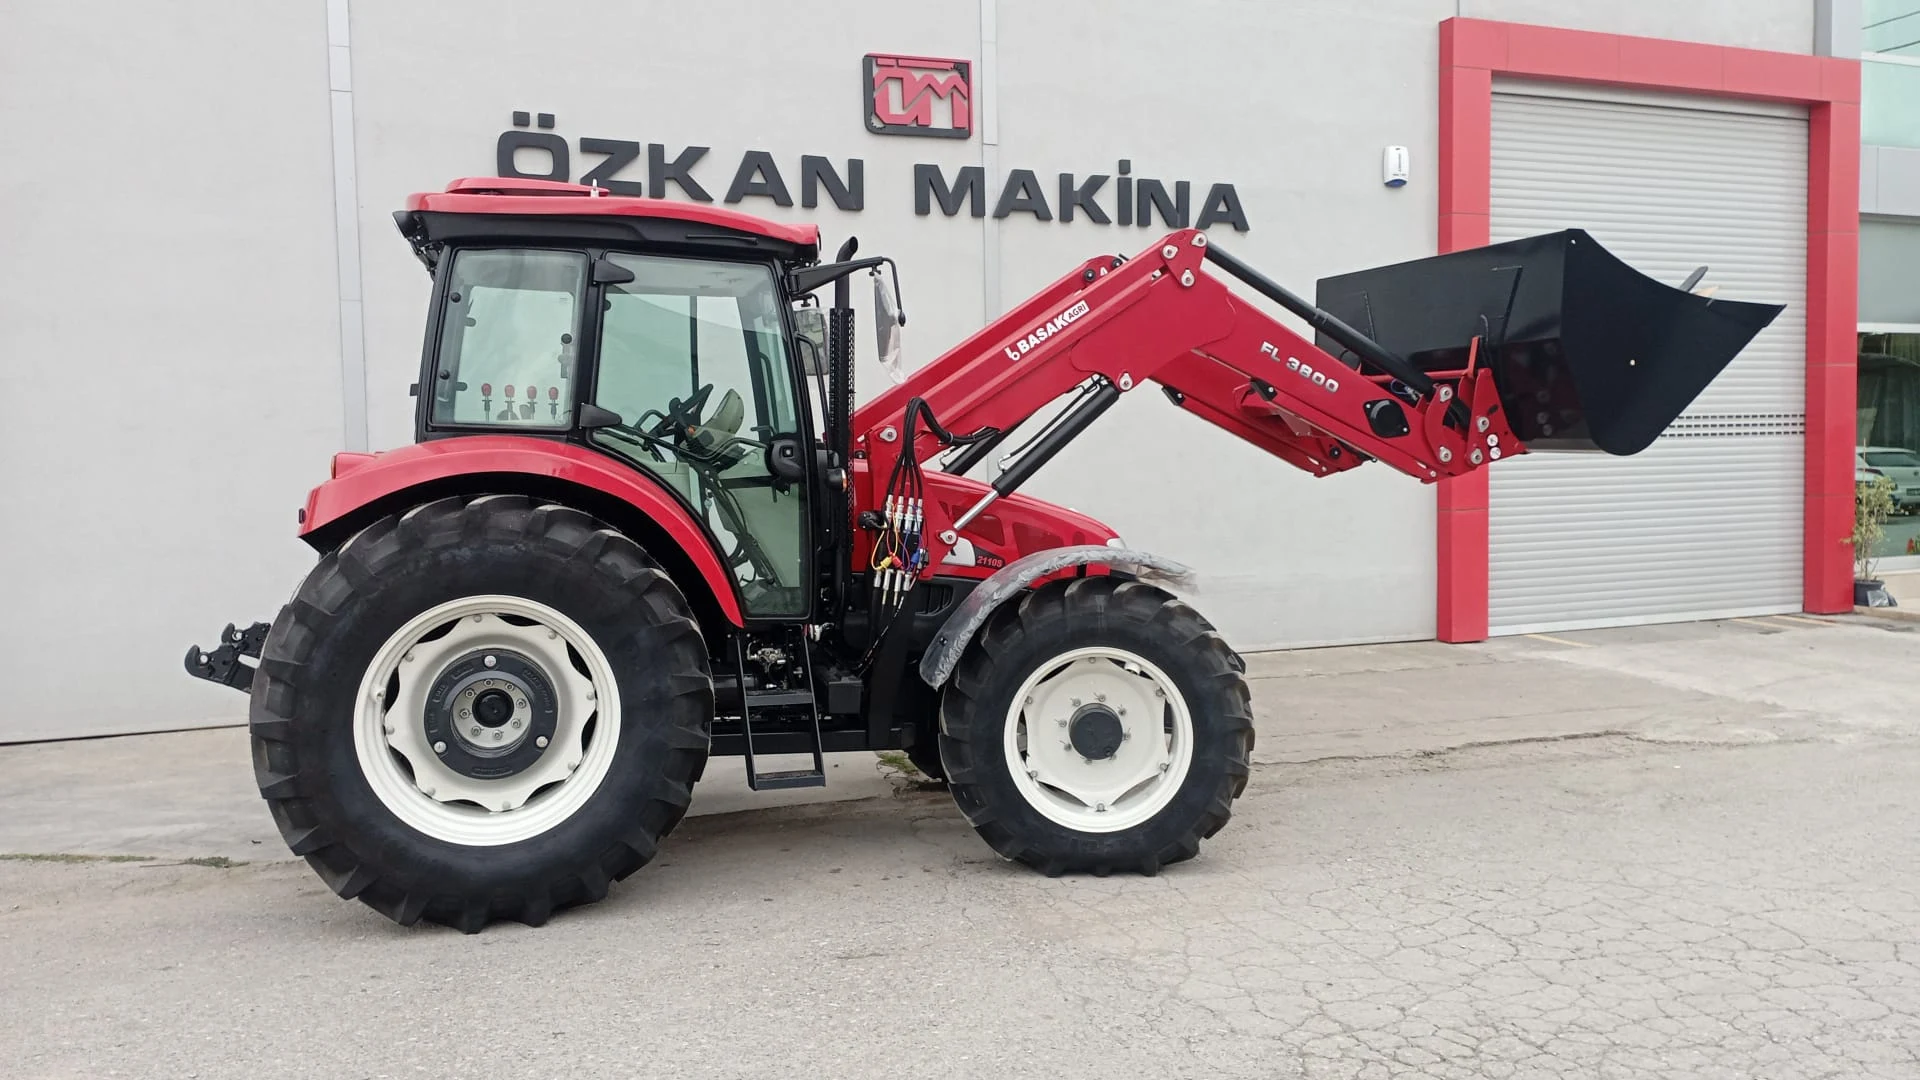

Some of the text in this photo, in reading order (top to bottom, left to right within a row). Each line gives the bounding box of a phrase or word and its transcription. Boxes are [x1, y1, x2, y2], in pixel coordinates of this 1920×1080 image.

[497, 110, 1251, 232] ÖZKAN MAKİNA
[1068, 303, 1087, 320] AGRI
[1260, 341, 1340, 393] FL 3800
